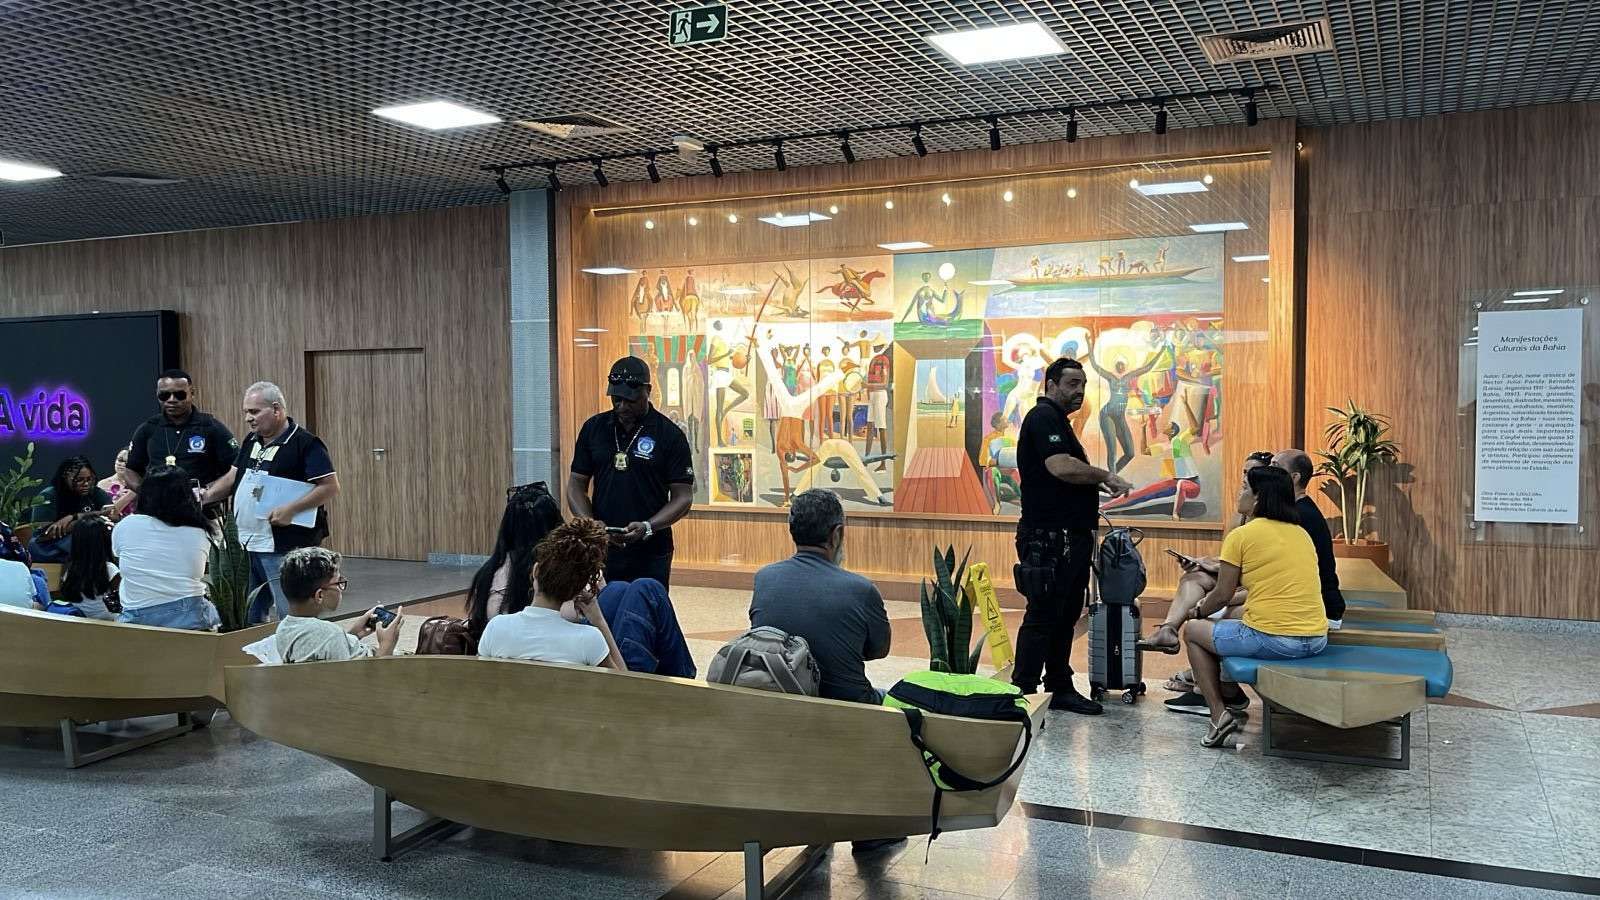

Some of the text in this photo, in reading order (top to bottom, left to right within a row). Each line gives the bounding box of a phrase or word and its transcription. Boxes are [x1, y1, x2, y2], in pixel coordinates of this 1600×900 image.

[1500, 335, 1558, 344] Manifestações
[1492, 344, 1528, 352] Culturais
[20, 392, 85, 432] vida
